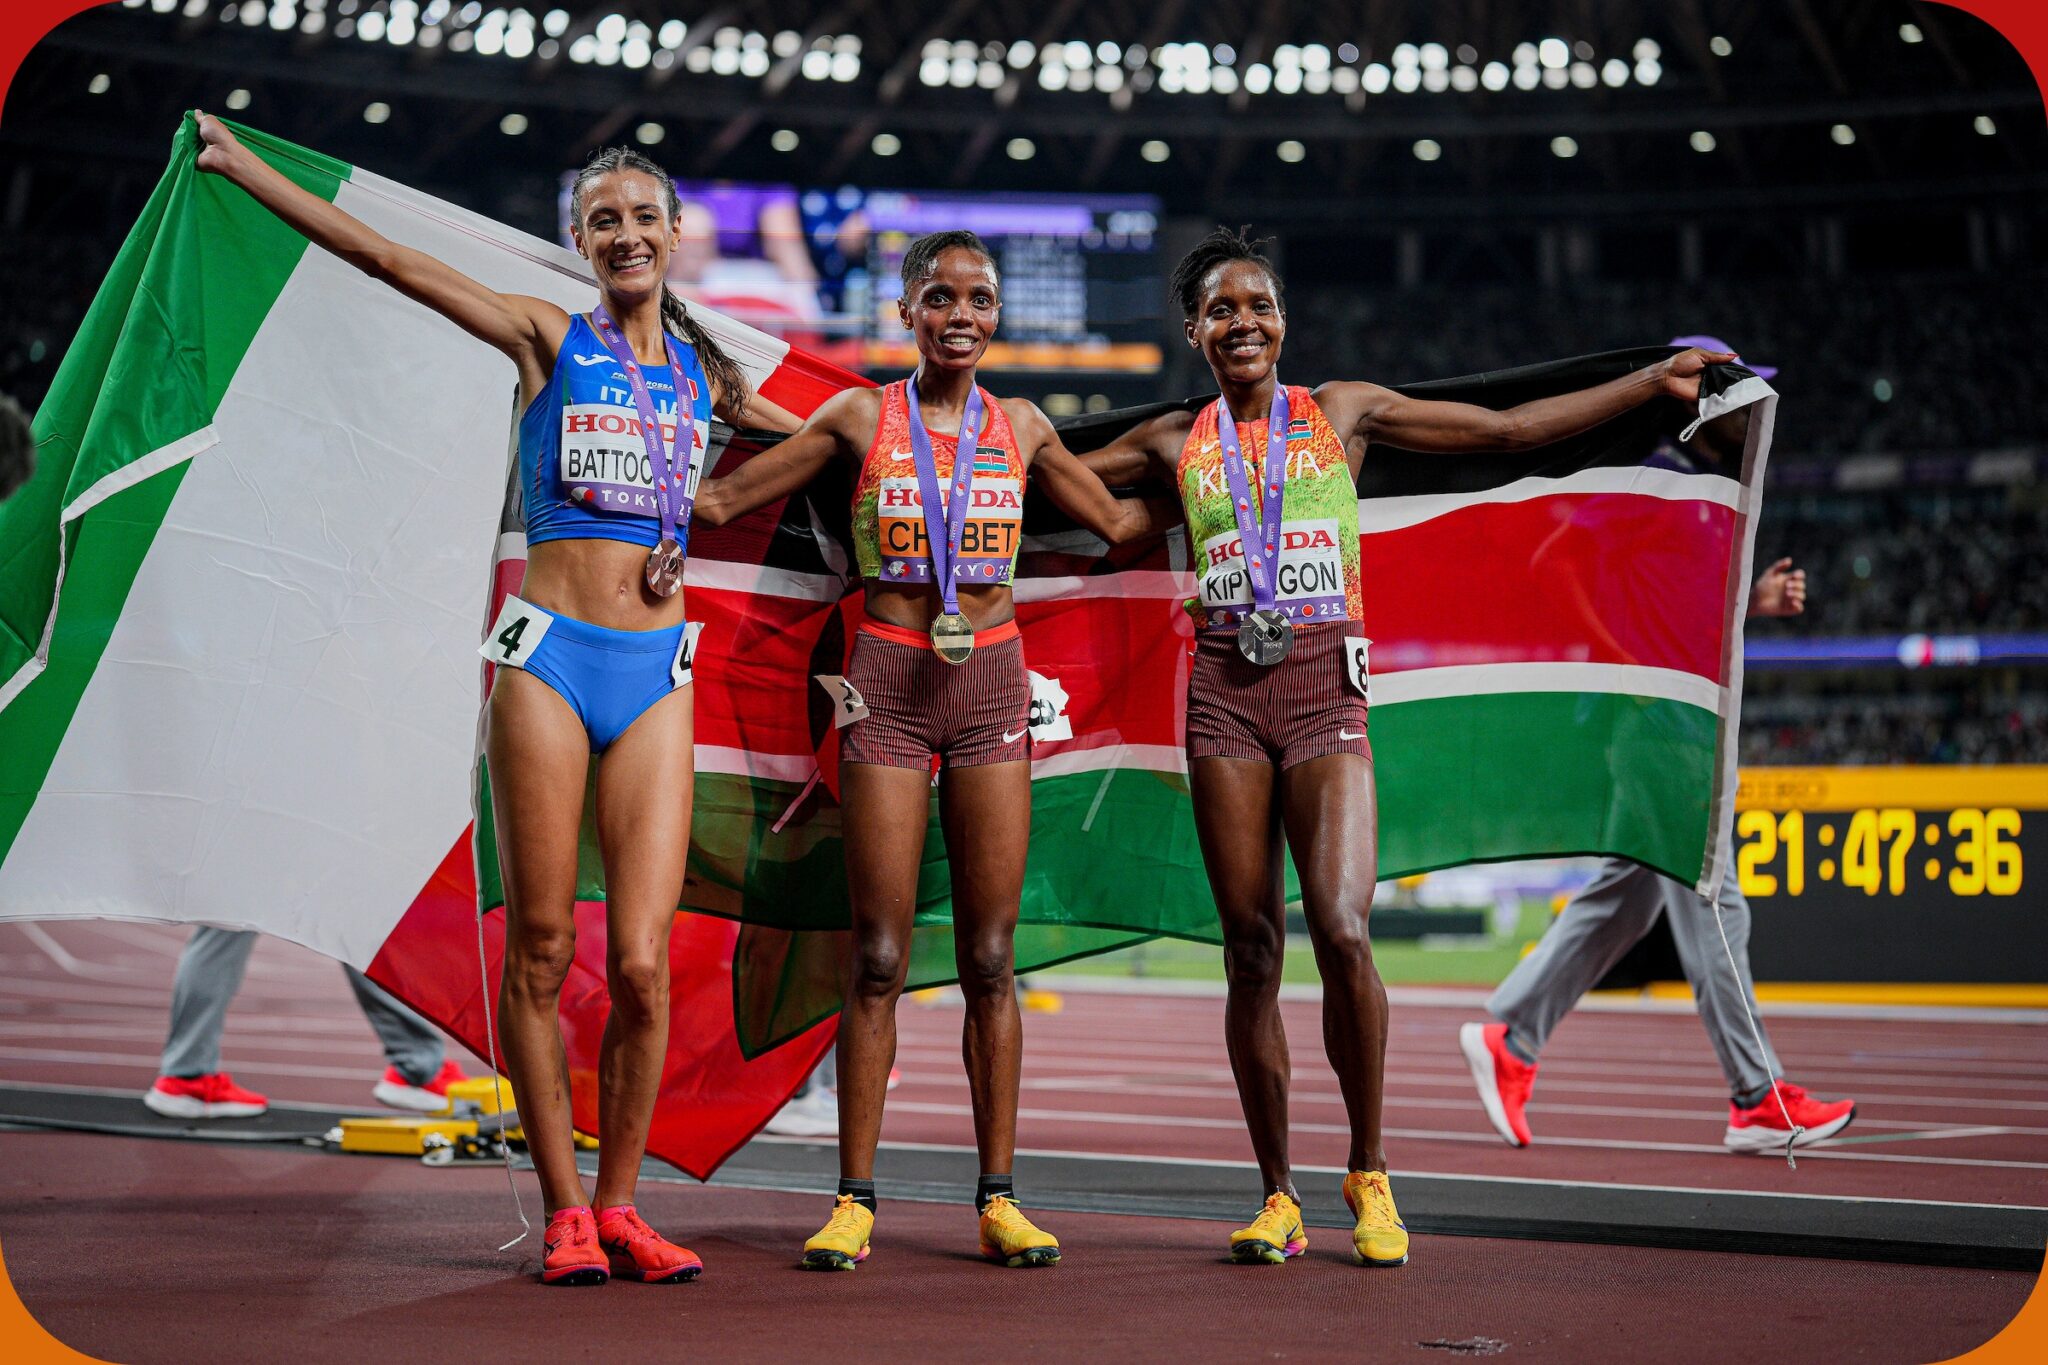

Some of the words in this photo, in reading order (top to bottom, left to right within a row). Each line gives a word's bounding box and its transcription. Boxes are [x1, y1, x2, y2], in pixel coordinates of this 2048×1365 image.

[568, 449, 699, 495] BATTOCTI
[602, 490, 658, 509] TOKY
[883, 489, 1020, 508] HDA
[888, 521, 1016, 552] CHBET
[1208, 530, 1336, 566] HODA
[1206, 561, 1337, 601] KIPGON
[1320, 603, 1340, 615] 25
[498, 616, 530, 659] 4
[1355, 647, 1368, 692] 8
[1737, 808, 2023, 896] 21:47:36
